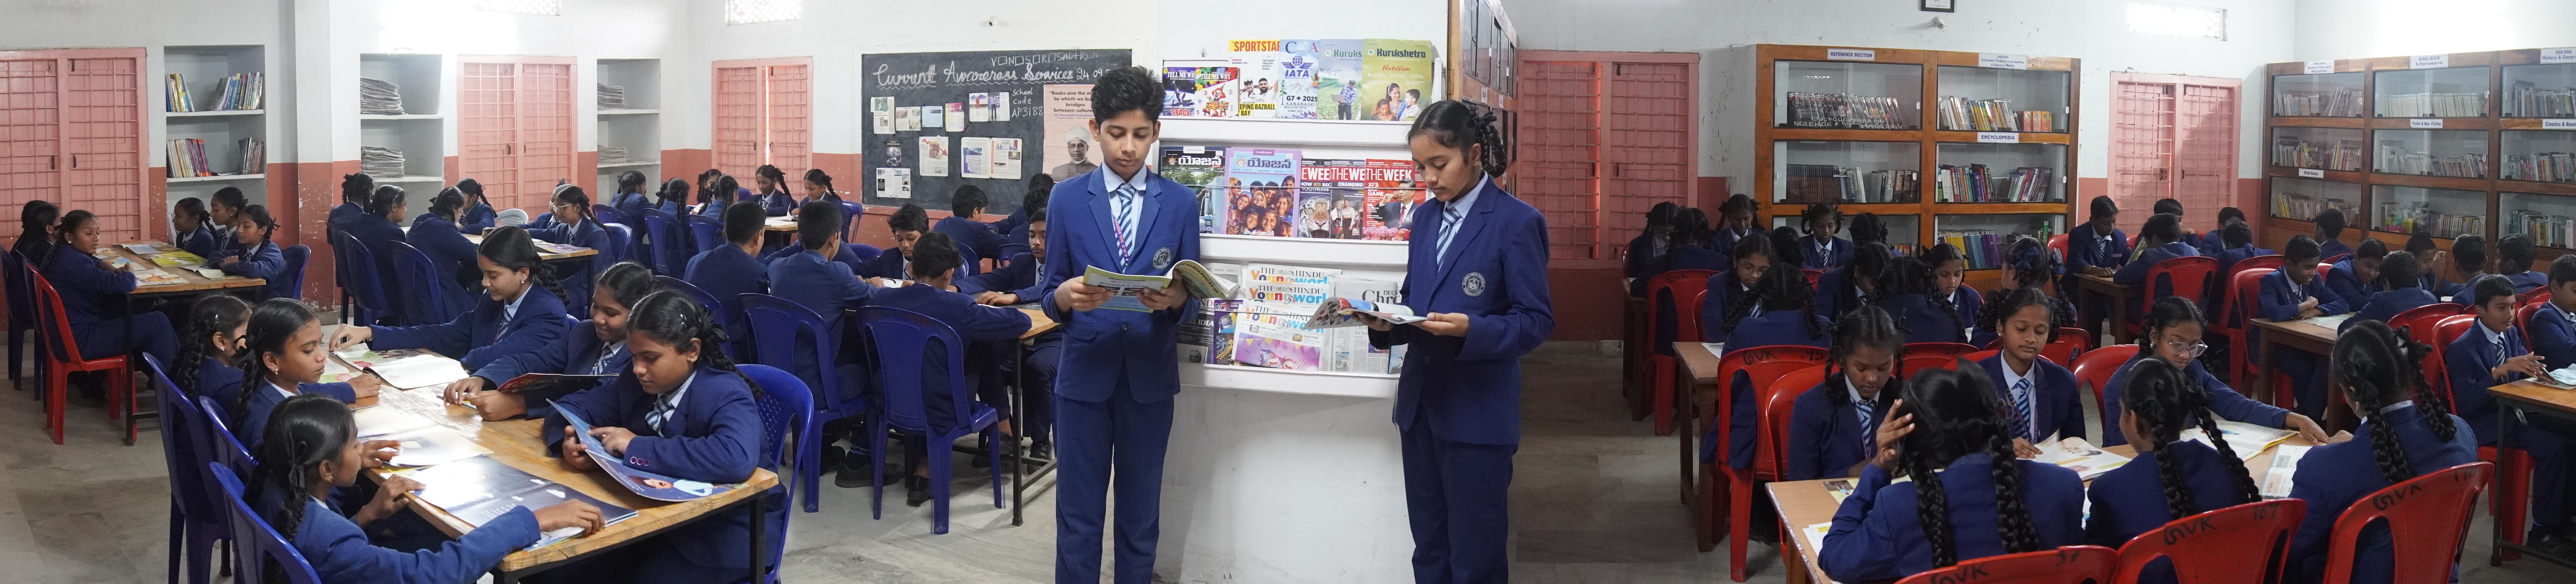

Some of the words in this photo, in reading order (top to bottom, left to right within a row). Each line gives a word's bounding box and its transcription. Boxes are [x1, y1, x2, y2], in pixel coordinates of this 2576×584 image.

[1334, 49, 1362, 58] Kuruks
[1377, 48, 1426, 58] Kurukshetra
[873, 64, 937, 86] Current
[944, 60, 1018, 84] Awareness
[1022, 63, 1074, 81] Services
[1012, 87, 1033, 96] School
[1178, 155, 1222, 166] యోజన
[1247, 158, 1291, 168] యోజన
[1251, 270, 1294, 283] Young
[1295, 276, 1327, 284] worl
[1296, 270, 1324, 278] HINDU
[1249, 288, 1291, 305] Young
[1293, 293, 1326, 304] worl
[1246, 307, 1285, 329] Young
[1290, 312, 1310, 322] HIND
